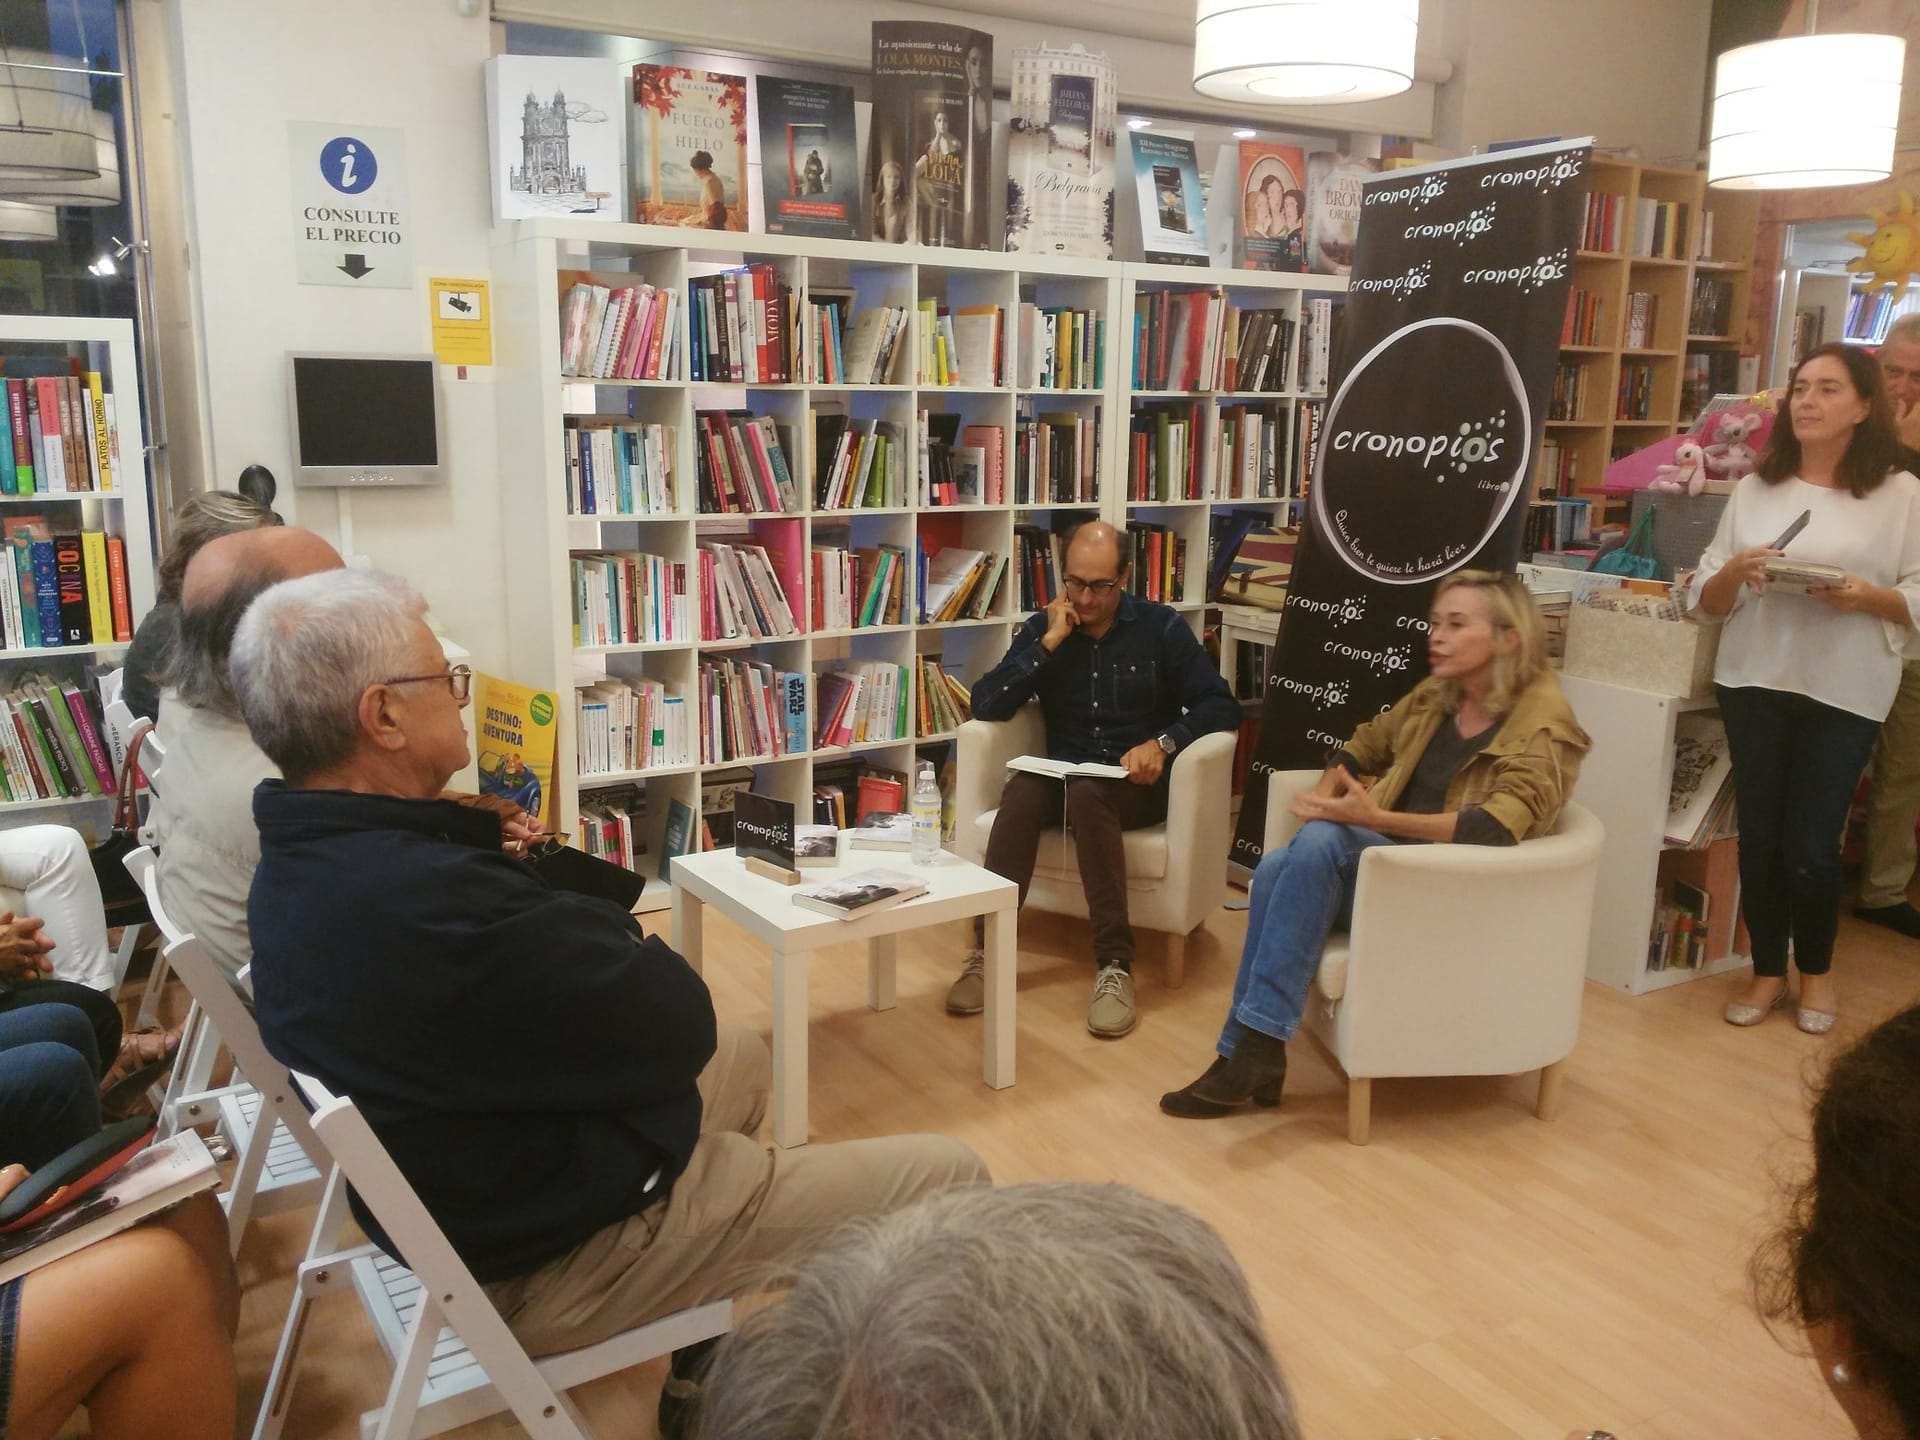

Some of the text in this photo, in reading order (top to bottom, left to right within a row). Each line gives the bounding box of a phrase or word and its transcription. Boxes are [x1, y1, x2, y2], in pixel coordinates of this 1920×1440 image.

[673, 111, 725, 129] FUEGO
[676, 135, 724, 151] HIELO
[924, 163, 961, 185] LOLA
[1481, 156, 1582, 188] cronopios
[1326, 190, 1361, 208] BROW
[1365, 176, 1448, 206] cronopios
[303, 207, 400, 226] CONSULTE
[1329, 208, 1360, 222] ORIGE
[1404, 209, 1496, 240] cronopios
[306, 226, 402, 245] EL PRECIO
[1350, 267, 1430, 295] cronopios
[1463, 256, 1568, 287] cronopios
[767, 298, 780, 343] MODA
[94, 398, 110, 471] PLATOS AL HORNO
[1334, 424, 1505, 469] cronopios
[1477, 479, 1502, 491] libro
[1336, 509, 1467, 574] Quien bien te quiere te hará leer
[56, 540, 83, 604] COCINA
[1286, 593, 1366, 620] cronopios
[1323, 640, 1410, 670] cronopios
[789, 678, 805, 715] STAR WARS
[1269, 673, 1348, 705] cronopios
[486, 706, 522, 729] DESTINO:
[483, 722, 524, 748] AVENTURA
[736, 820, 789, 842] cronopios
